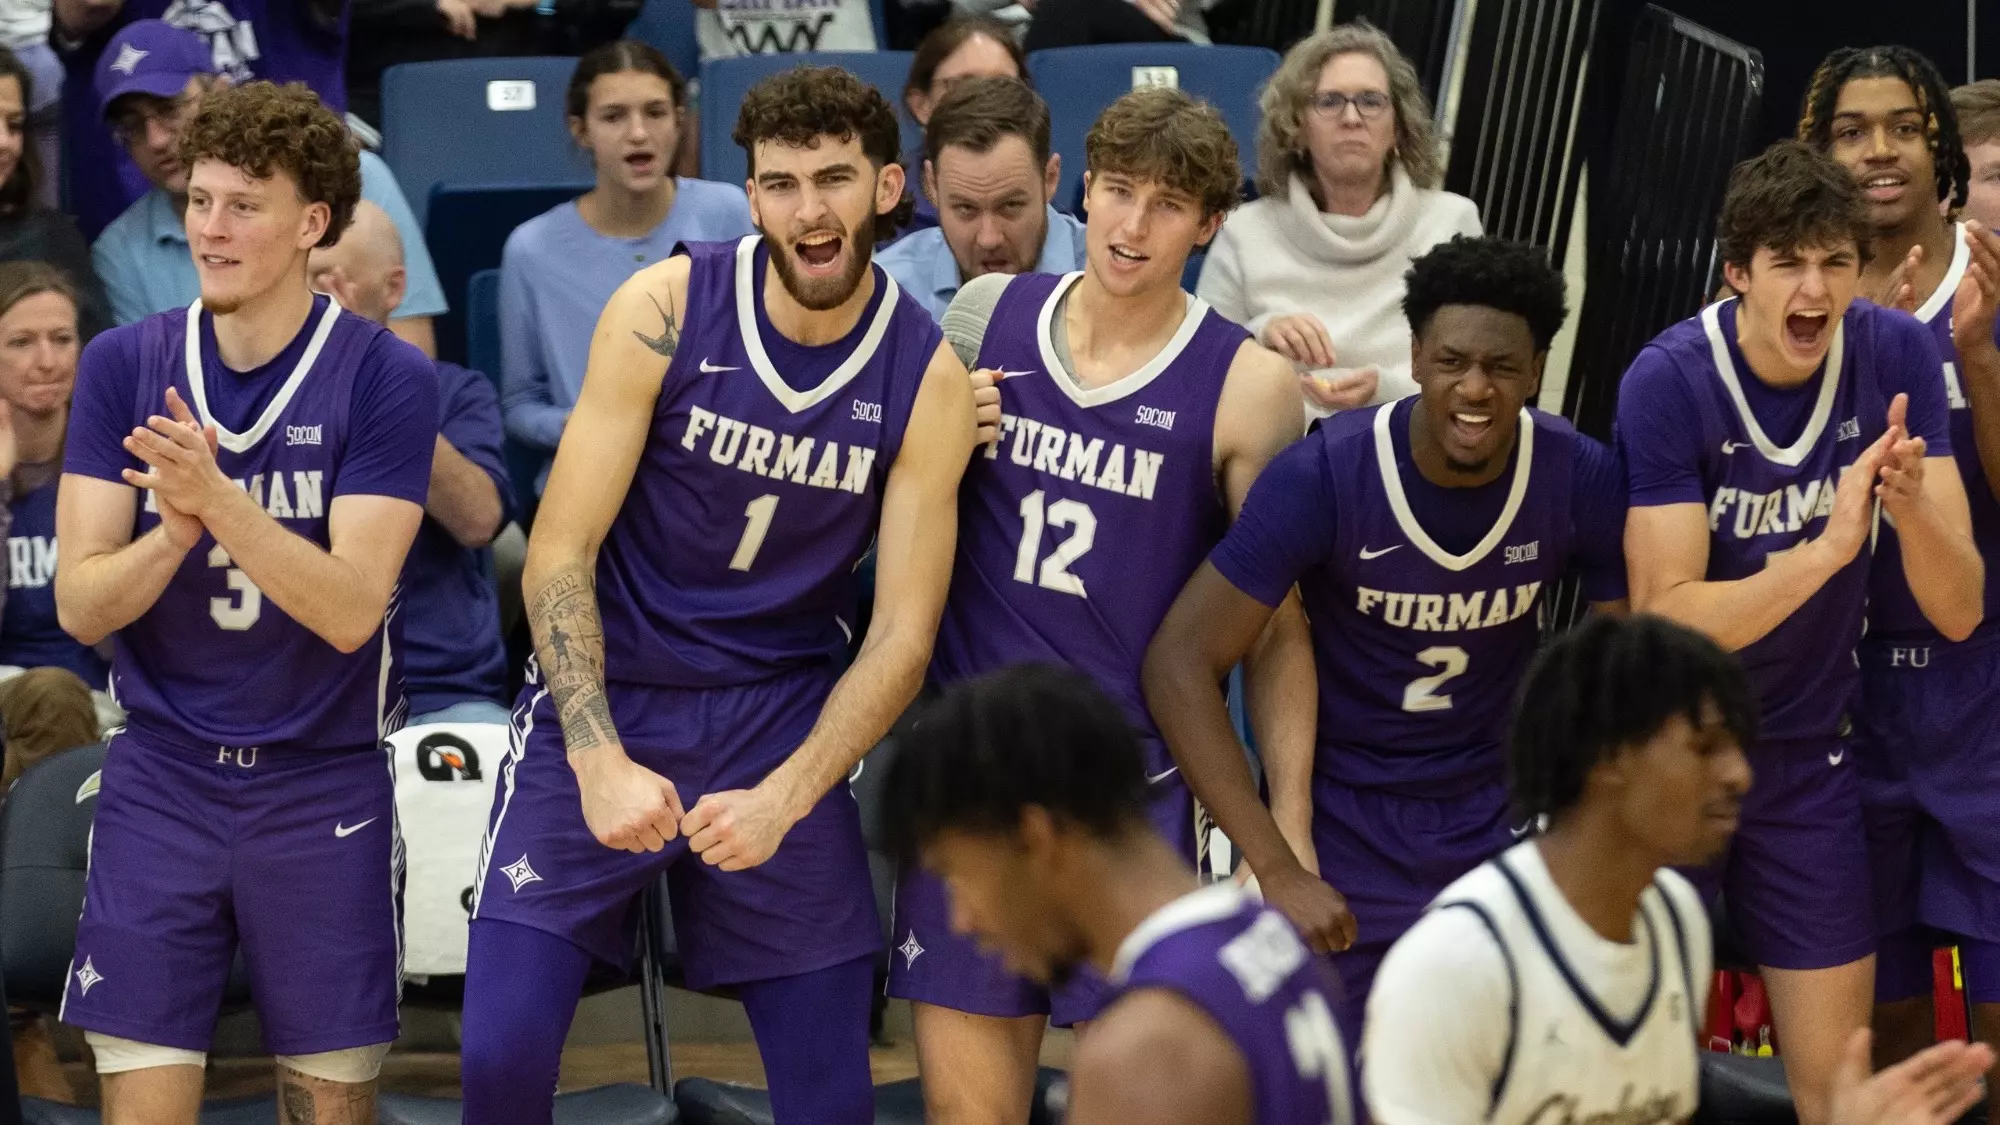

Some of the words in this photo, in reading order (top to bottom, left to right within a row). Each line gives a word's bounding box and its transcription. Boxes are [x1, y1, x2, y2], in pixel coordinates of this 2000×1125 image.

[852, 399, 882, 424] SOCO
[681, 404, 877, 494] FURMAN
[984, 413, 1165, 500] FURMAN
[728, 493, 780, 572] 1
[1709, 465, 1854, 539] FURMA
[1013, 488, 1098, 599] 12
[208, 544, 262, 631] 3
[1356, 580, 1543, 632] FURMAN
[1402, 645, 1470, 712] 2
[1891, 647, 1931, 668] FU
[216, 745, 259, 768] FU
